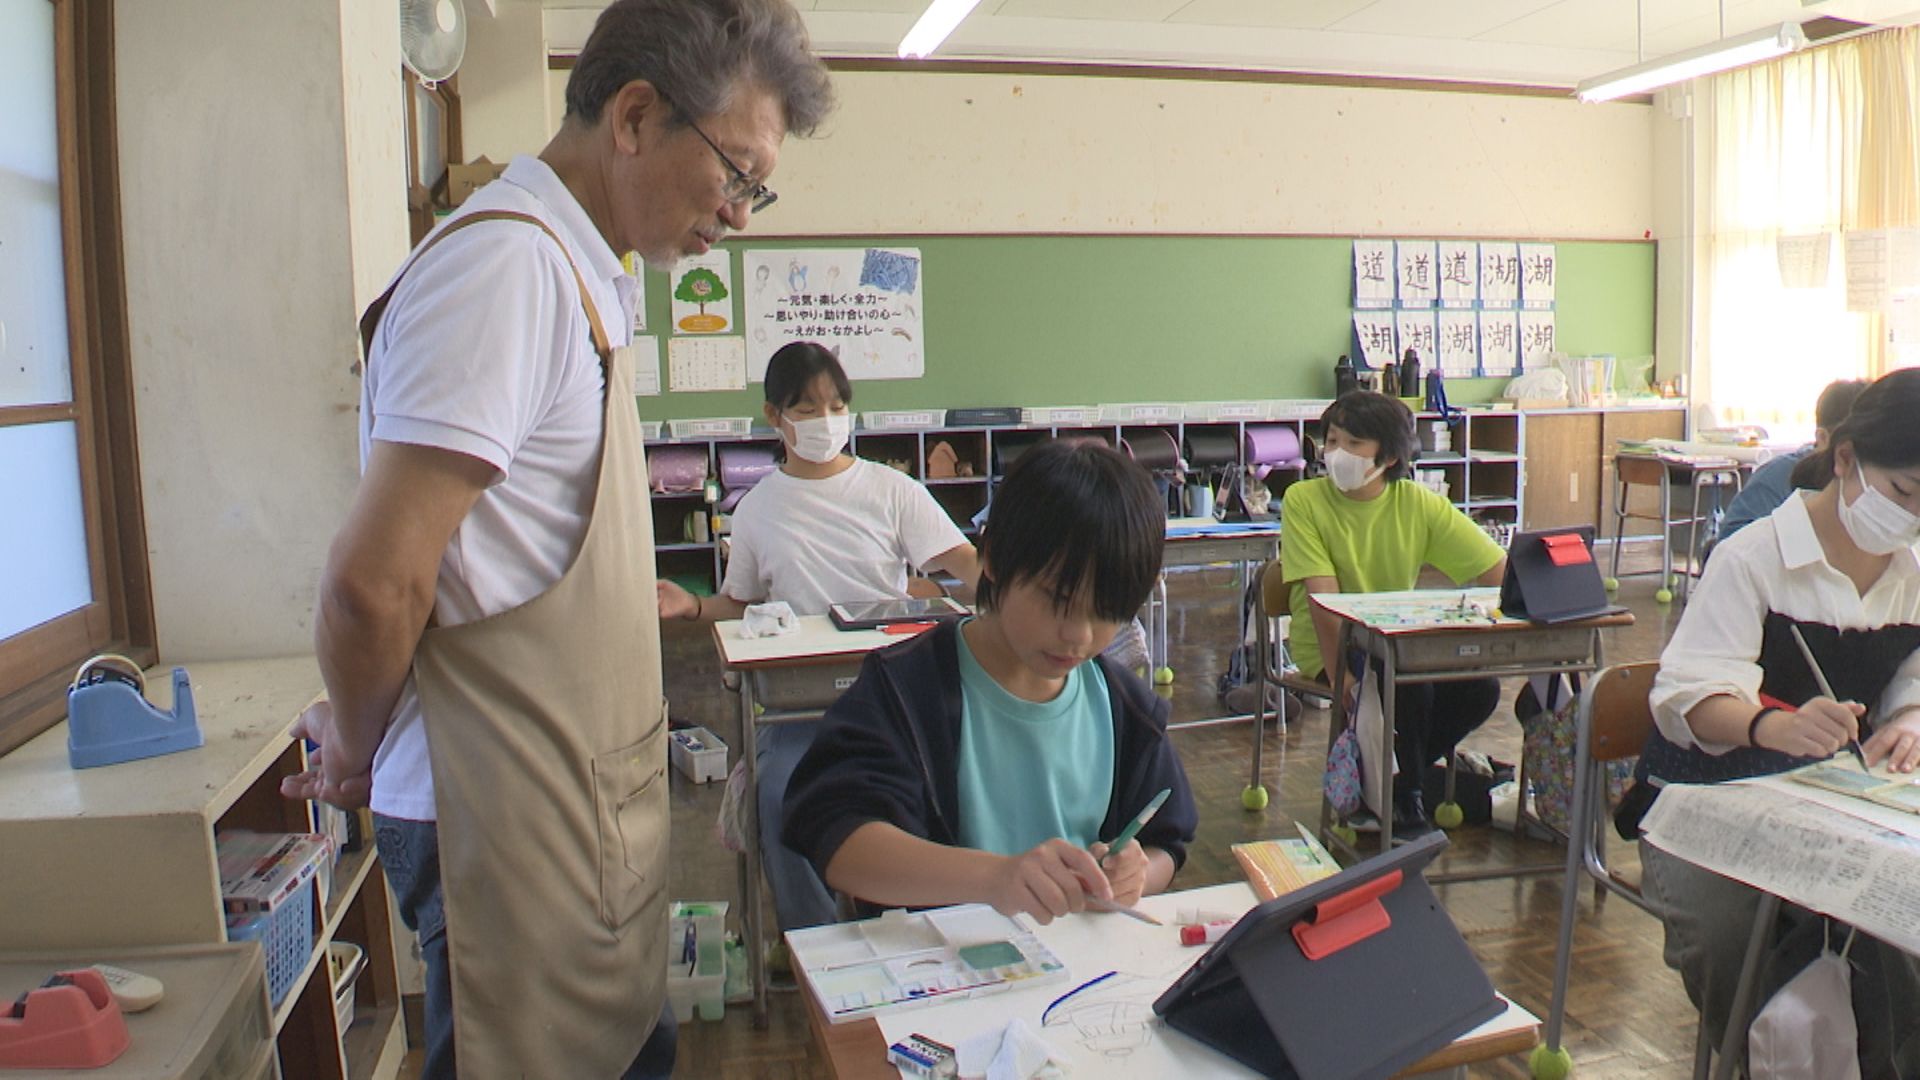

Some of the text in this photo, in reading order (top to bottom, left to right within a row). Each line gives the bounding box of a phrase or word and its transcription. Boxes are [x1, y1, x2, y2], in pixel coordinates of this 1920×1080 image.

[1361, 251, 1385, 281] 道
[1405, 253, 1429, 290] 道
[1445, 251, 1472, 286] 道
[1488, 256, 1517, 285] 湖
[1527, 254, 1553, 285] 湖
[1362, 325, 1393, 354] 湖
[1405, 324, 1434, 354] 湖
[1447, 324, 1474, 354] 湖
[1488, 321, 1513, 353] 湖
[1527, 325, 1554, 353] 湖
